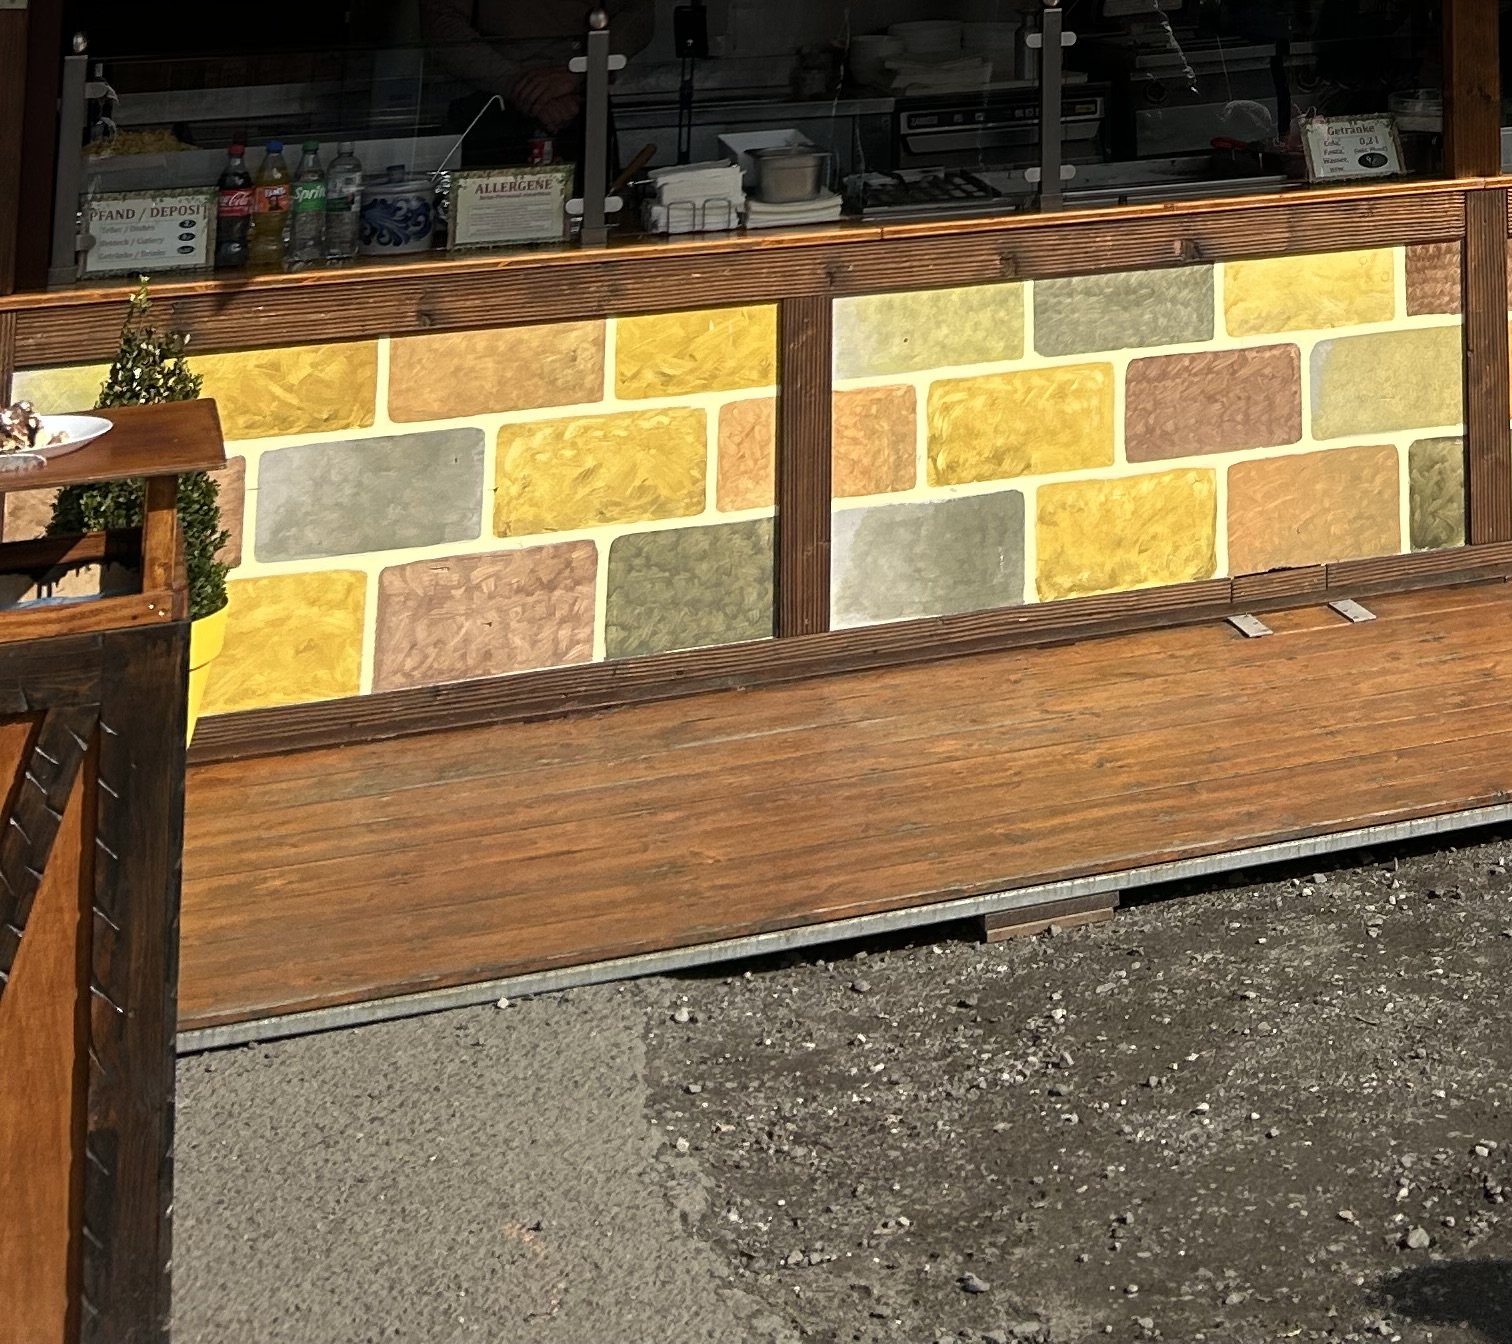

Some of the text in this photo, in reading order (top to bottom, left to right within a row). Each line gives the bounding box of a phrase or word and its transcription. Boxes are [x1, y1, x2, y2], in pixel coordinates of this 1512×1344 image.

[1327, 124, 1375, 136] Getränke
[475, 178, 553, 195] ALLERGENE
[89, 208, 136, 222] PFAND
